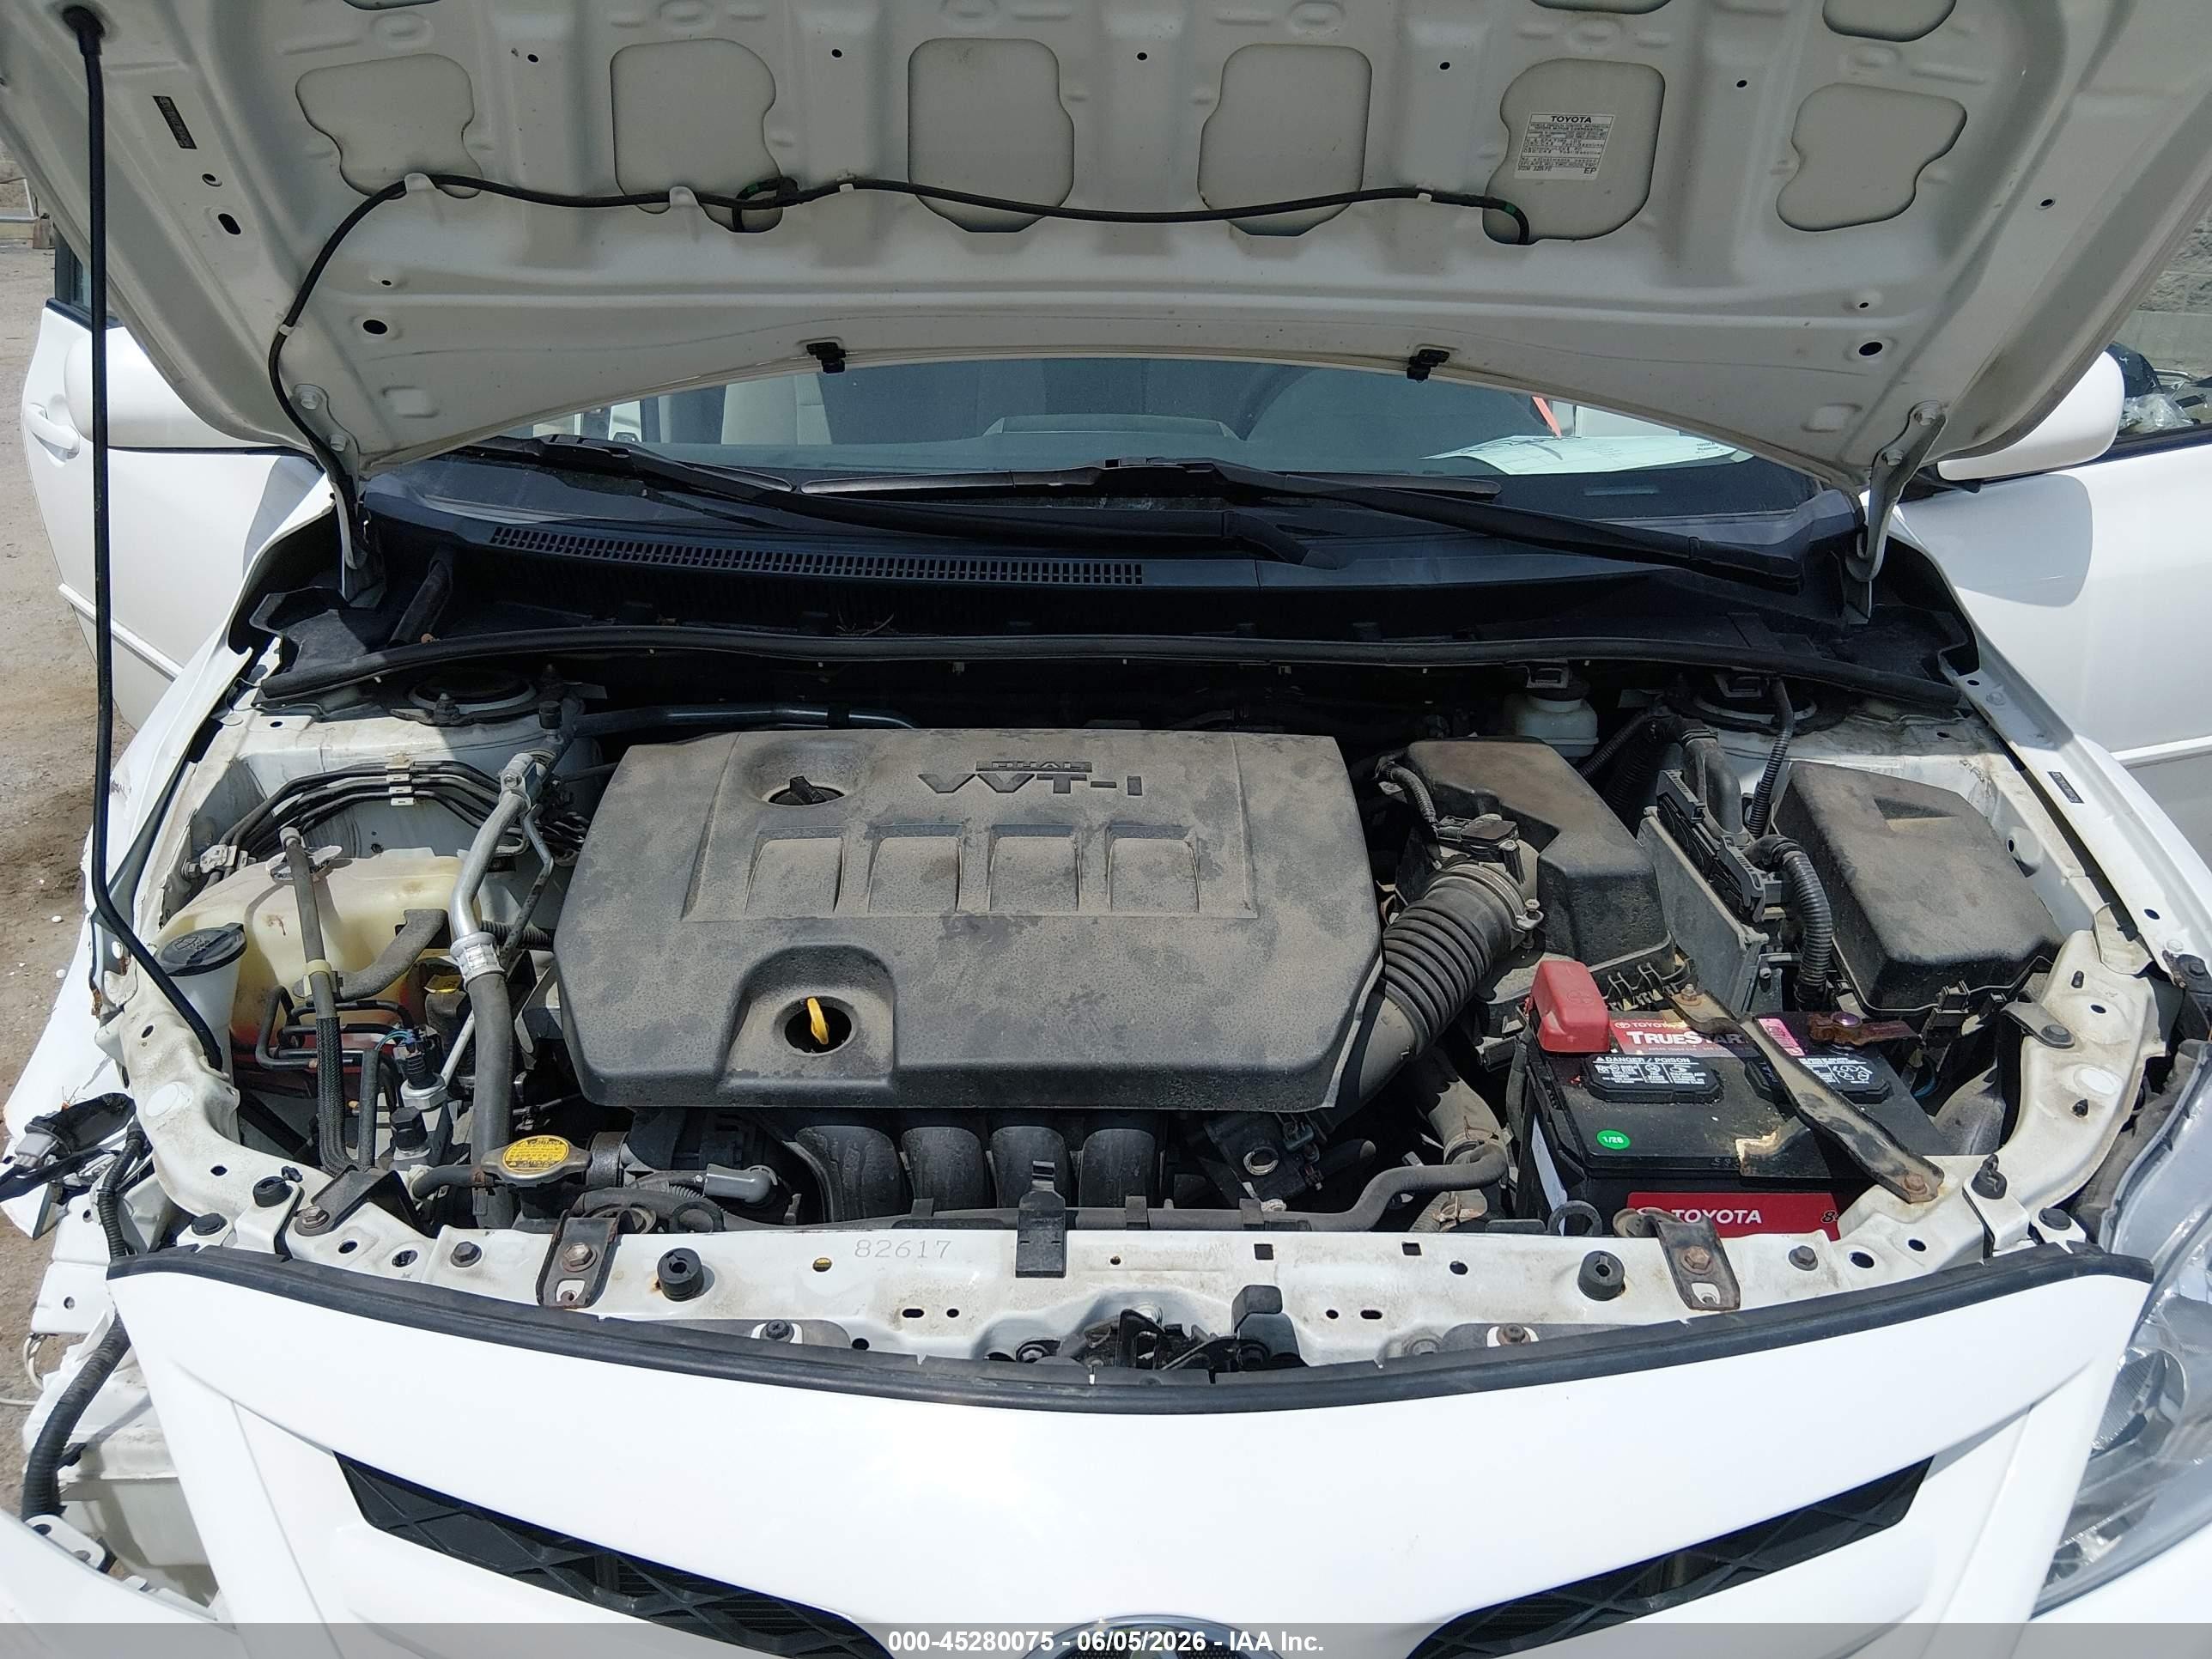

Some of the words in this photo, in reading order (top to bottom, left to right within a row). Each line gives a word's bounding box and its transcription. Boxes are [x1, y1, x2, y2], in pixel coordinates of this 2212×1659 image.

[991, 761, 1089, 772] DUAL
[1671, 1209, 1762, 1224] TOYOTA
[855, 1239, 951, 1258] 82617
